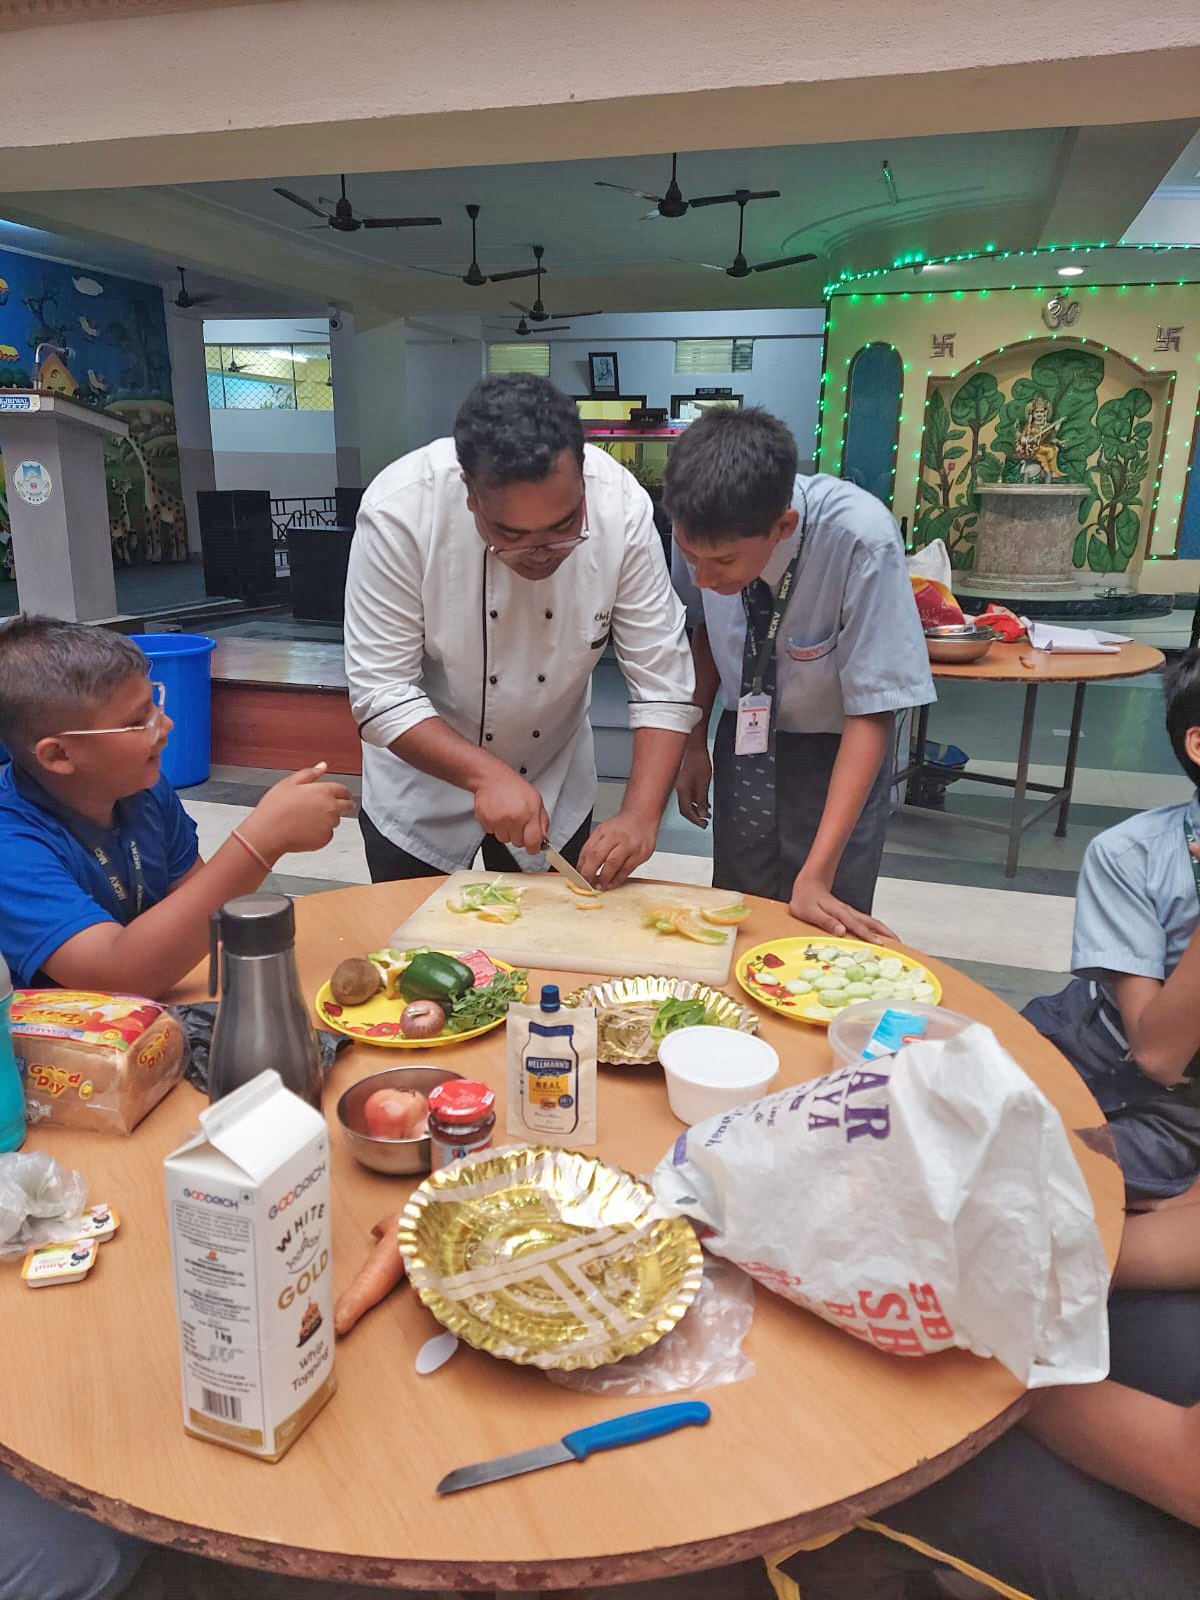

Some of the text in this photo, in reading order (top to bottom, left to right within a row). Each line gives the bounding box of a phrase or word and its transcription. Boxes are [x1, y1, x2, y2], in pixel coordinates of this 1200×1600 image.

[779, 571, 792, 600] MCKV
[594, 611, 610, 621] Chef
[767, 611, 781, 640] MCKV
[129, 840, 142, 870] MCKV
[138, 1029, 171, 1066] Good
[146, 1048, 166, 1070] Day
[29, 1063, 82, 1085] Good
[36, 1075, 66, 1097] Day
[535, 1081, 561, 1090] REAL
[183, 1187, 239, 1211] GOODRICH
[268, 1160, 327, 1220] GOODRICH
[275, 1203, 325, 1253] WHITE
[277, 1248, 329, 1311] GOLD
[291, 1347, 330, 1391] Topping
